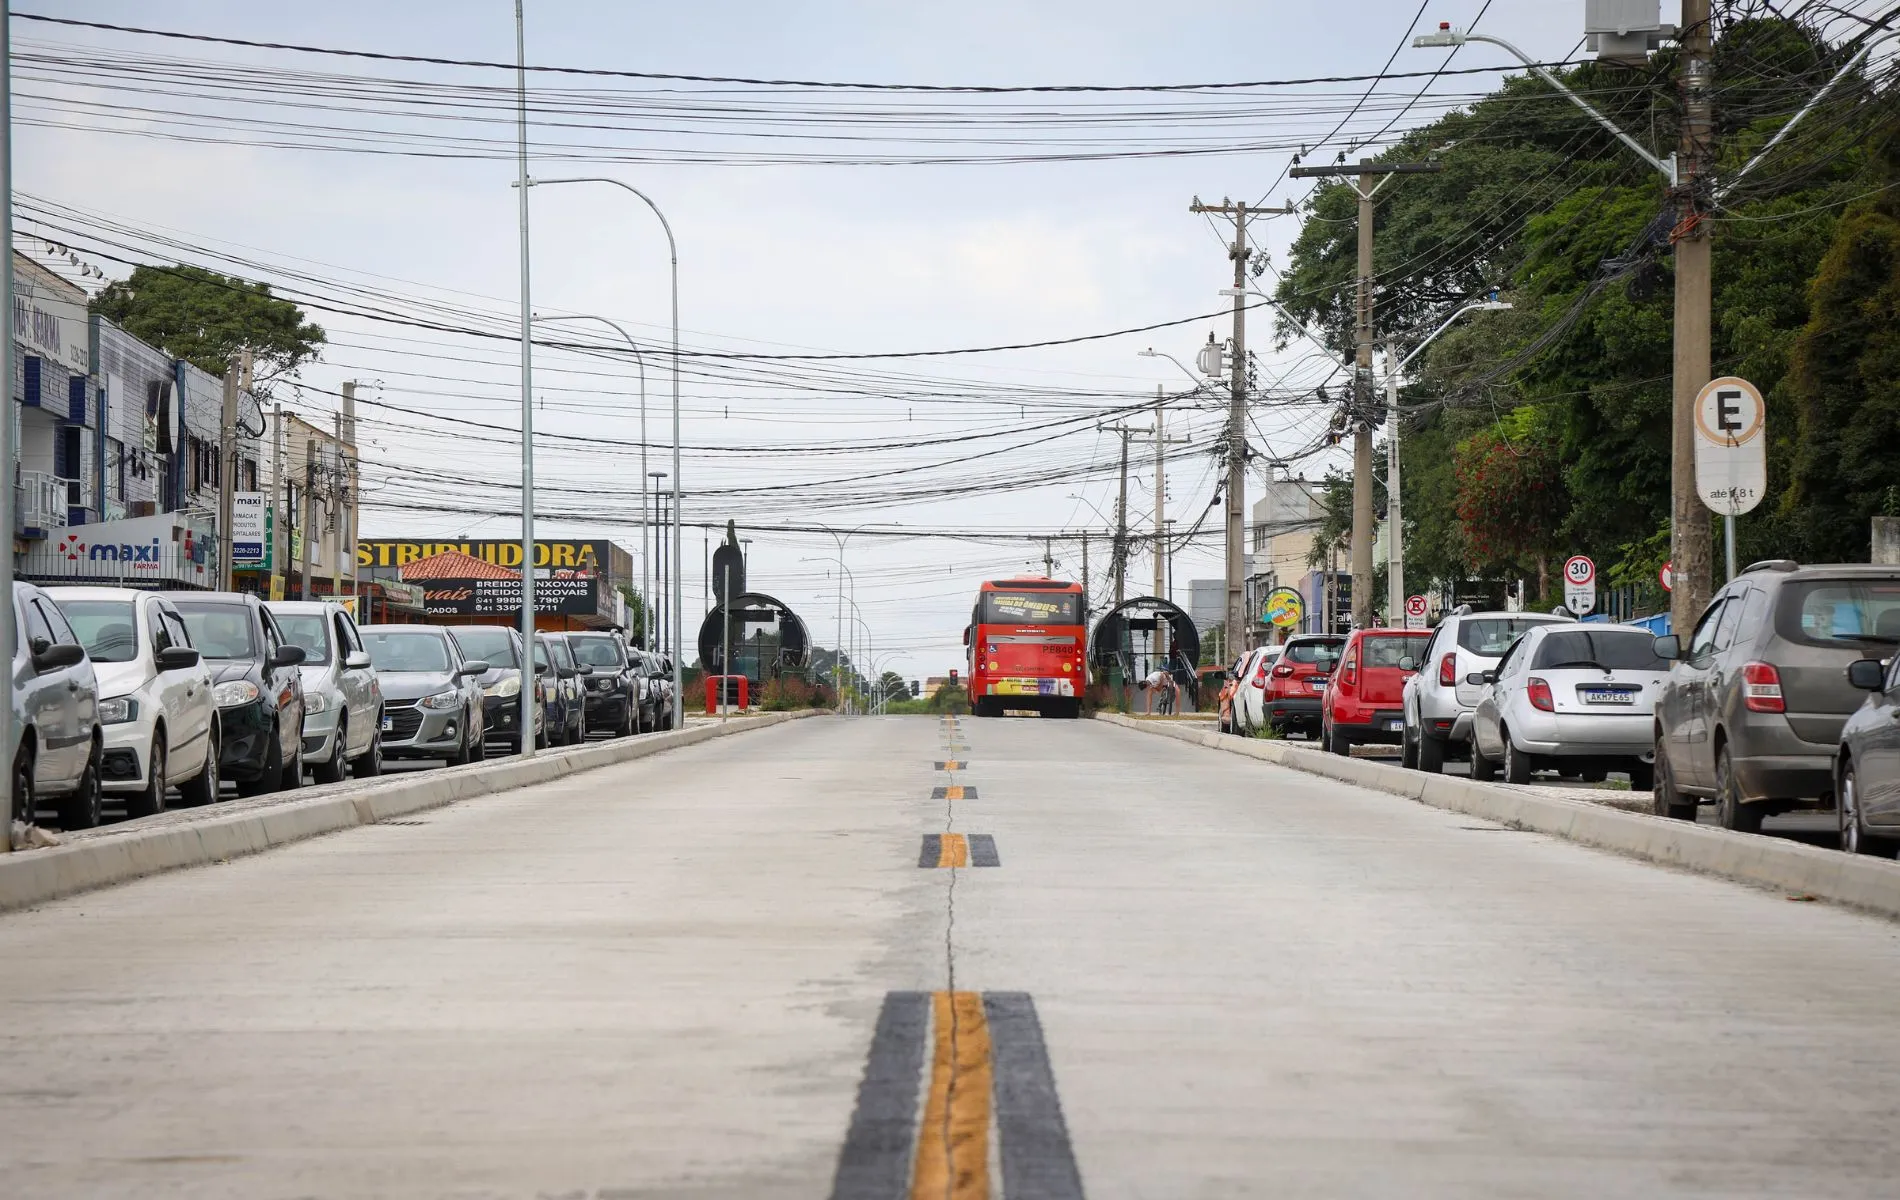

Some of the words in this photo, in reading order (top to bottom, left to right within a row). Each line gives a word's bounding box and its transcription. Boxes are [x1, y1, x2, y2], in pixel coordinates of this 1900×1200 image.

[1717, 391, 1742, 430] E
[237, 496, 261, 505] maxi
[1710, 489, 1727, 499] até
[90, 538, 160, 562] maxi
[1571, 562, 1589, 575] 30
